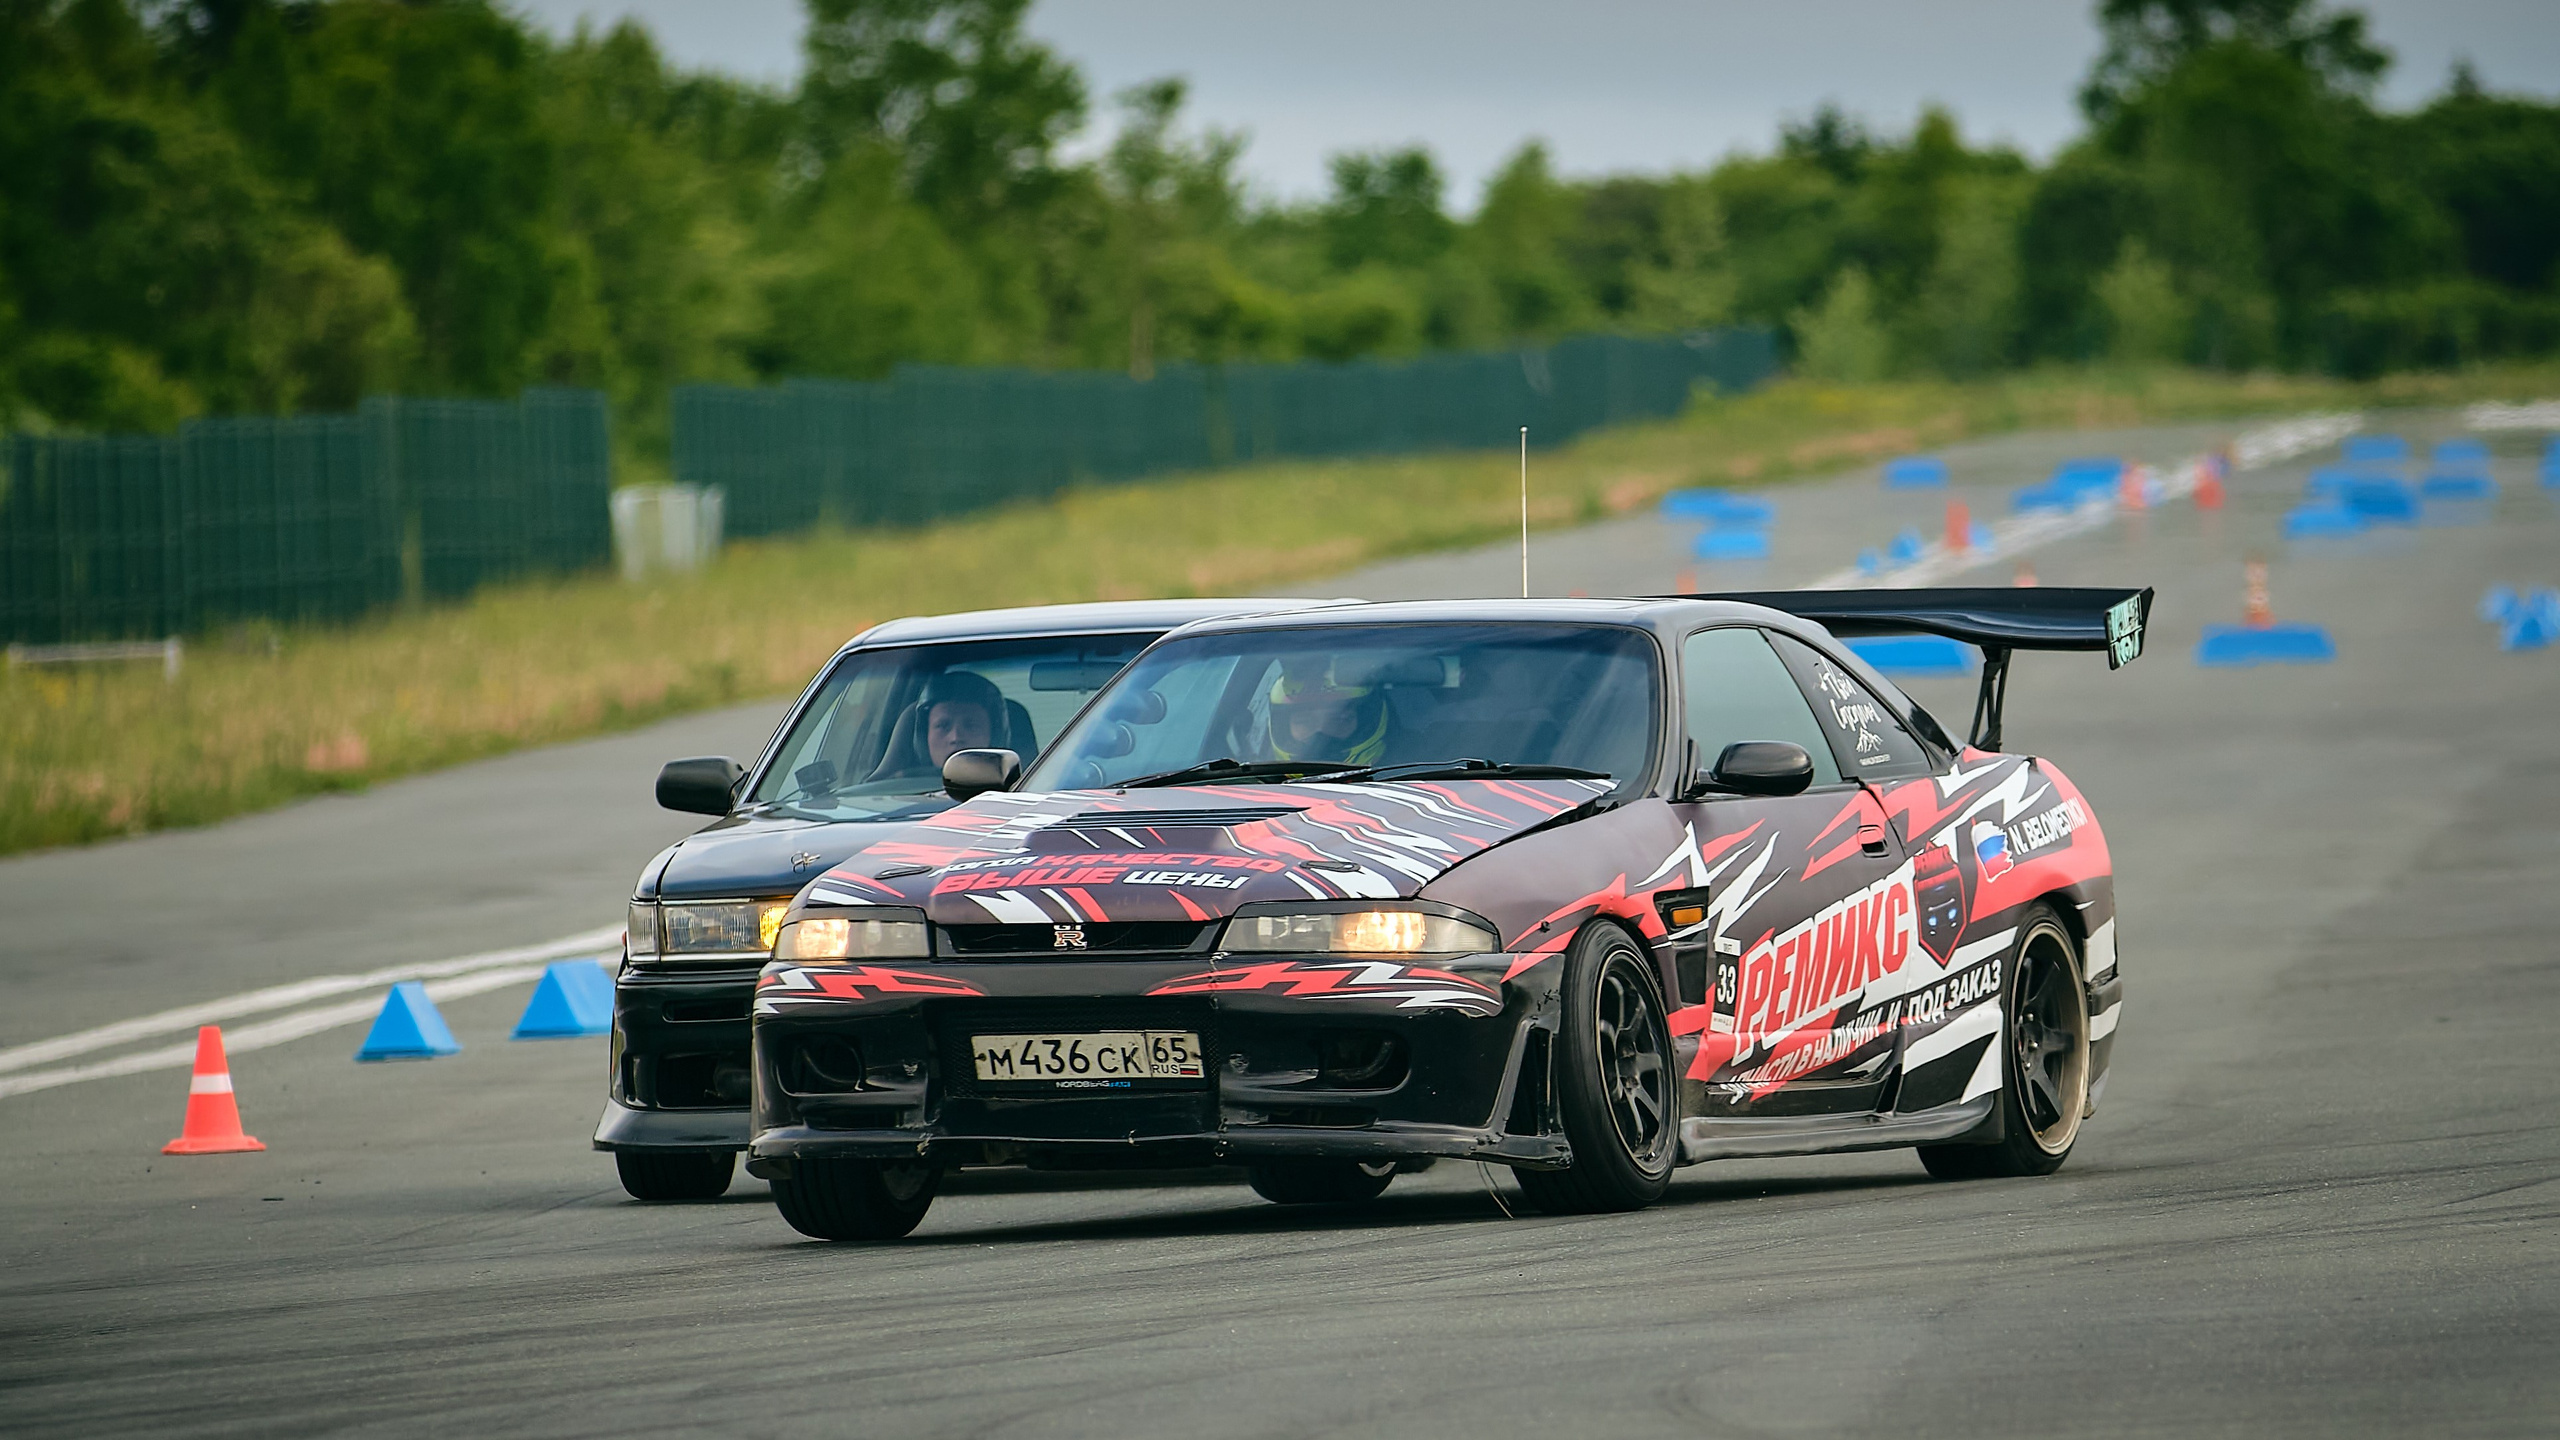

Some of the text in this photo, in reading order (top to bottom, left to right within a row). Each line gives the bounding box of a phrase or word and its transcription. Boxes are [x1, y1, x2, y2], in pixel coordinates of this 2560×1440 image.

[2008, 824, 2029, 855] N.
[1032, 854, 1286, 873] КАЧЕСТВО
[930, 866, 1250, 897] ВЫШЕ ЦЕНЫ
[1717, 963, 1737, 1005] 33
[1737, 882, 1910, 1058] РЕМИКС
[1793, 1043, 1813, 1074] В
[1808, 1006, 1884, 1069] НАЛИЧИИ
[1886, 1000, 1903, 1032] И
[1907, 984, 1947, 1025] ПОД
[1946, 959, 2001, 1010] ЗАКАЗ
[1152, 1037, 1188, 1064] 65
[1151, 1064, 1180, 1075] RUS
